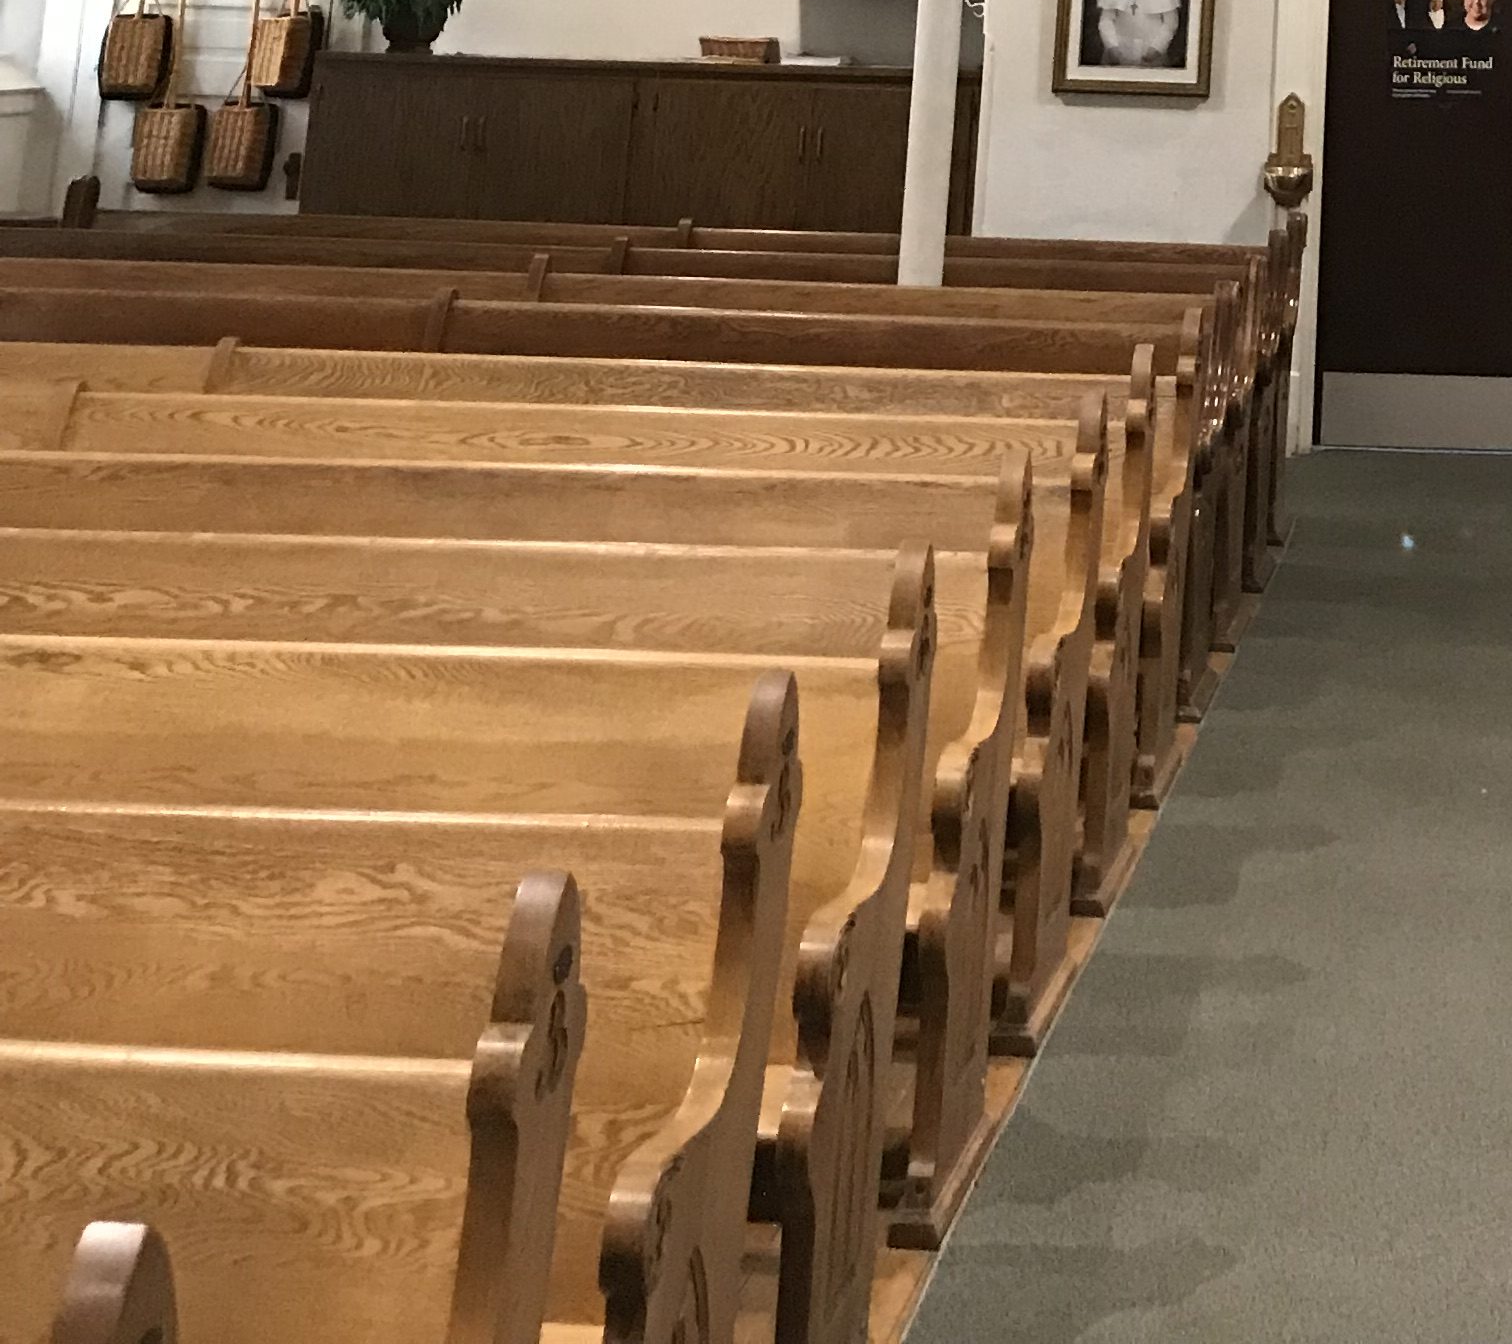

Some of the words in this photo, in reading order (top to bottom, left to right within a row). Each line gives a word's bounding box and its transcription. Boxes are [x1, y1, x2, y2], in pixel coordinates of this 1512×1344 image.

[1393, 55, 1458, 68] Retirement
[1461, 56, 1493, 69] Fund
[1392, 71, 1410, 83] for
[1413, 71, 1468, 88] Religious
